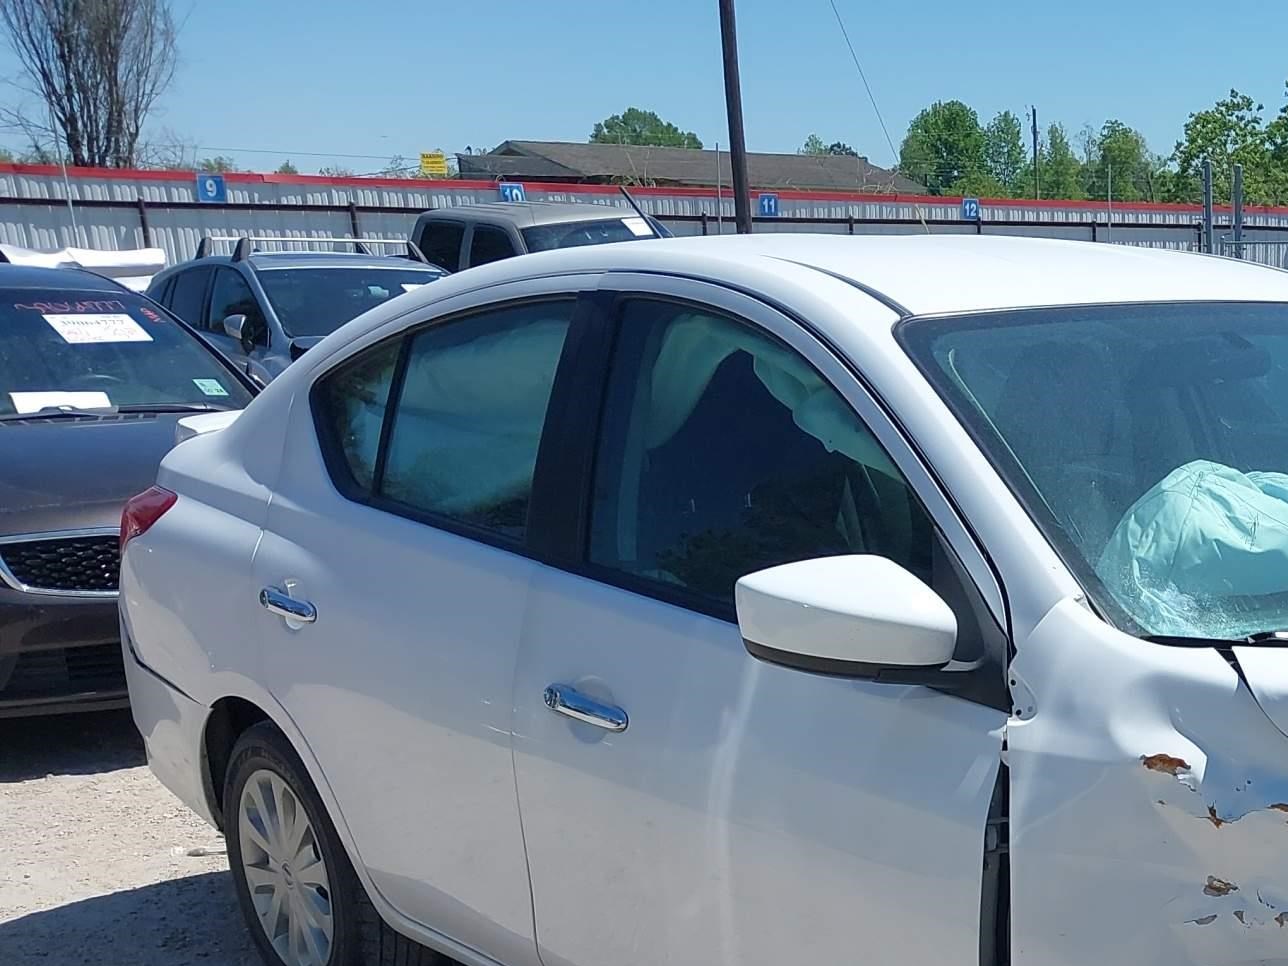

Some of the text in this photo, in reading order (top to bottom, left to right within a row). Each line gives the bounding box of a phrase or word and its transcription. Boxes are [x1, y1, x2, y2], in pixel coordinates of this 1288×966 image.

[205, 179, 218, 198] 9
[503, 187, 522, 201] 10
[762, 198, 776, 213] 11
[964, 202, 977, 217] 12
